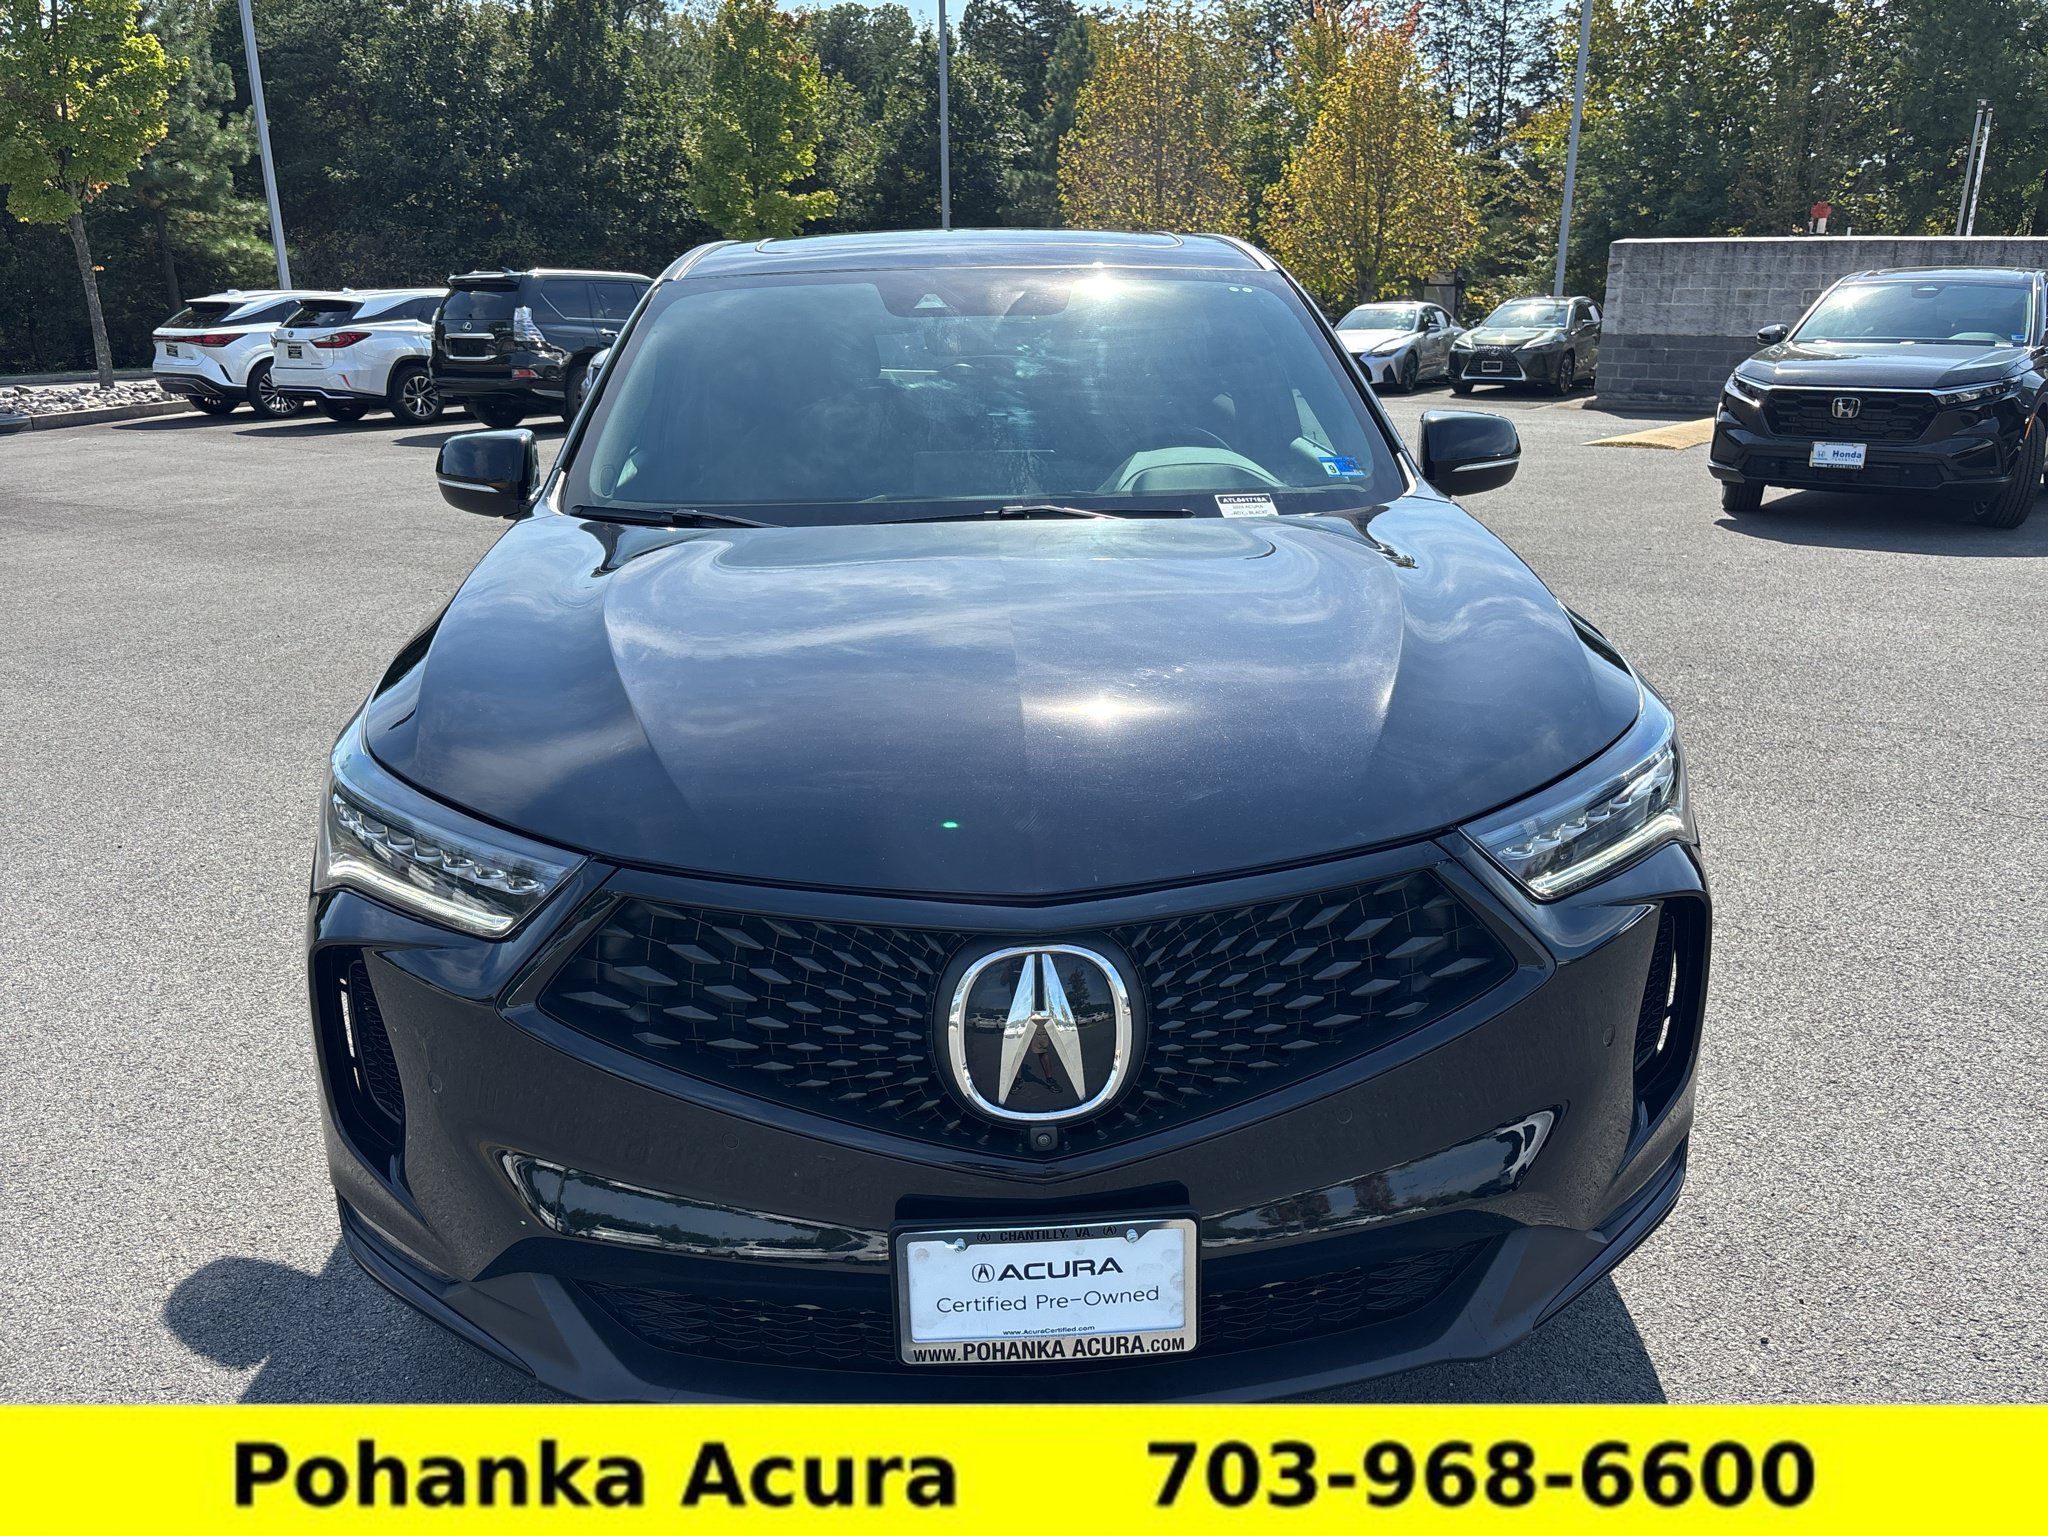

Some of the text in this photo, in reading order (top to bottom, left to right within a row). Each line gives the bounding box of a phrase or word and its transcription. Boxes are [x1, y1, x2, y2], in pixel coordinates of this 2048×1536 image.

[1832, 450, 1862, 459] Honda
[1328, 464, 1337, 473] 9
[1075, 1228, 1094, 1238] VA.
[998, 1257, 1123, 1282] ACURA
[936, 1285, 1159, 1313] Certified Pre-Owned
[1002, 1325, 1095, 1336] www.AcuraCertified.com
